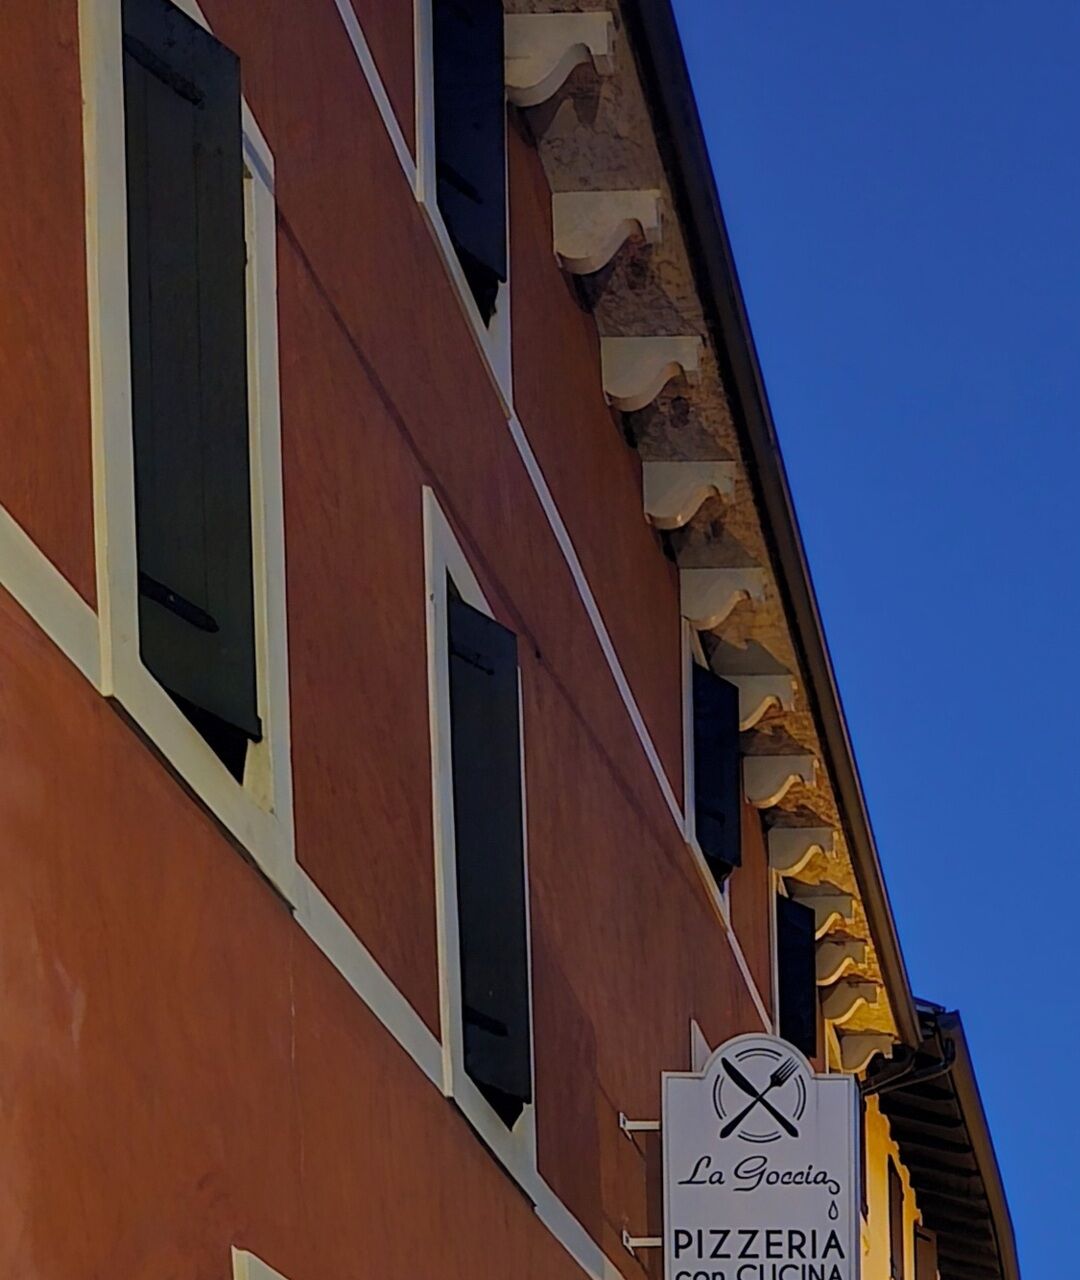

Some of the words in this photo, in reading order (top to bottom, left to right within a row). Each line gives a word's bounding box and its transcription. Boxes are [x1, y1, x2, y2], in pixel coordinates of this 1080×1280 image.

[677, 1155, 725, 1184] La
[733, 1155, 840, 1195] Goccia
[674, 1229, 845, 1259] PIZZERIA
